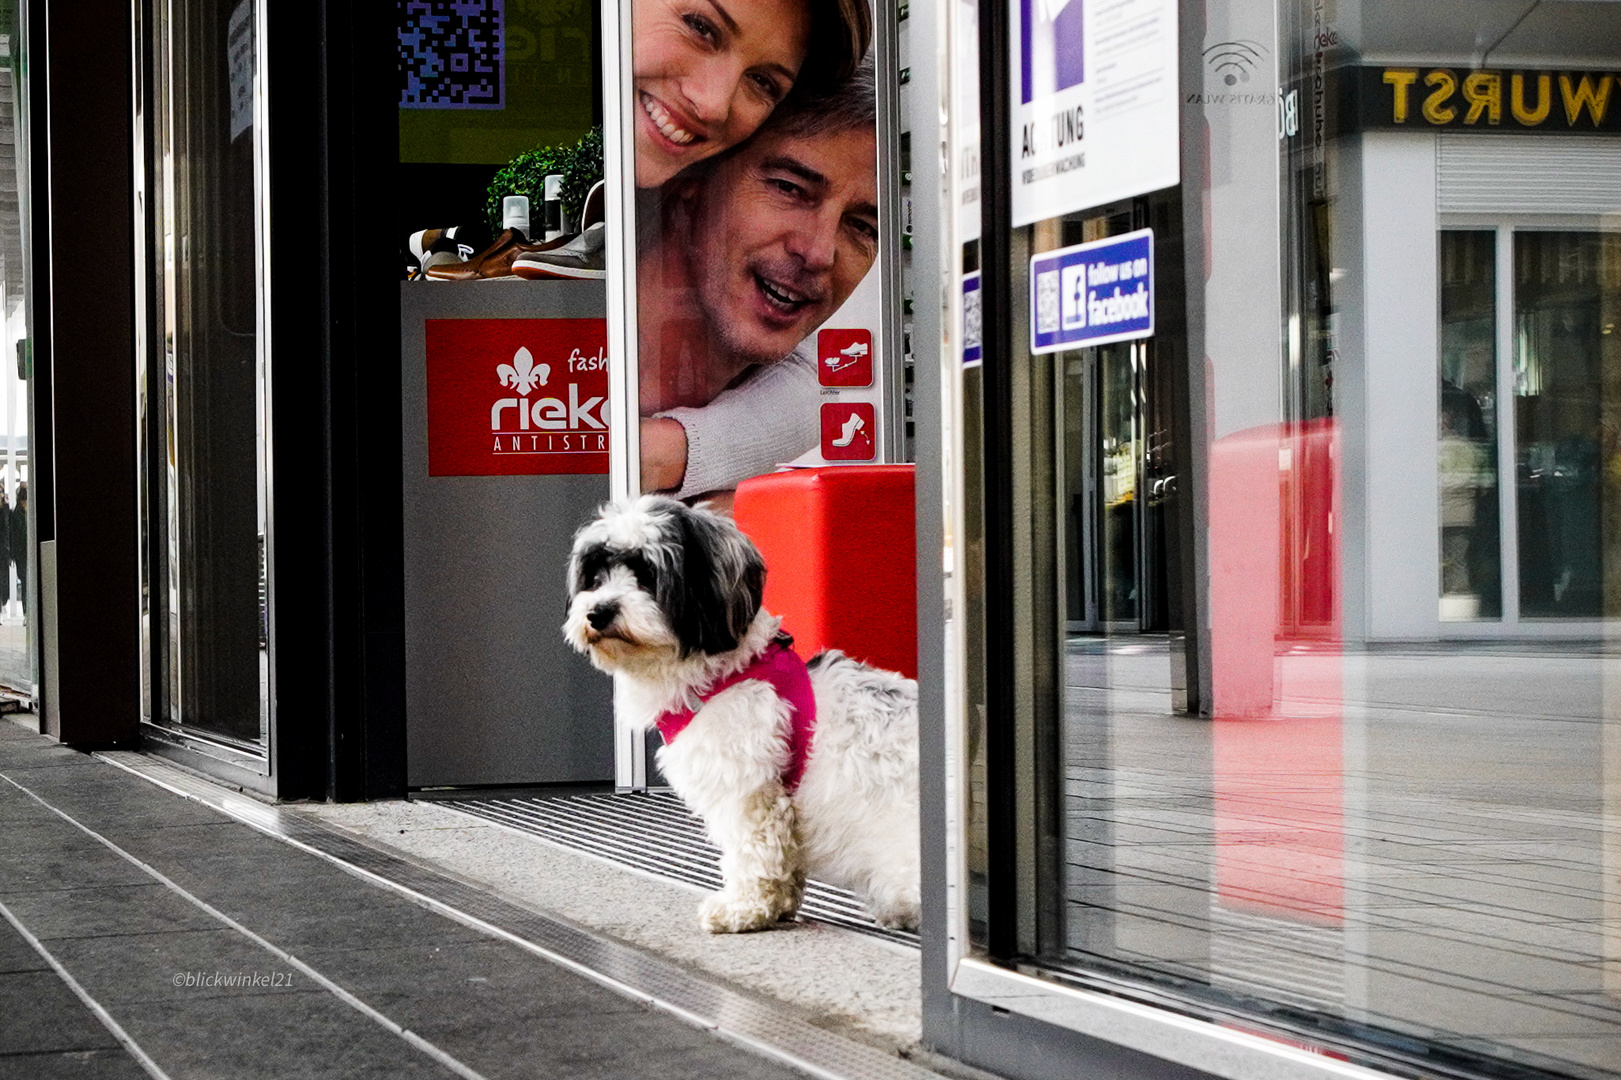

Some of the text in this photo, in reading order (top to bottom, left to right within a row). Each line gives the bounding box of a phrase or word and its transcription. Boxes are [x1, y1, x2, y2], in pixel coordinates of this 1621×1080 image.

[1088, 257, 1147, 287] follow us on
[1088, 281, 1148, 327] facebook
[491, 383, 609, 431] riek
[493, 435, 605, 451] ANTISTR
